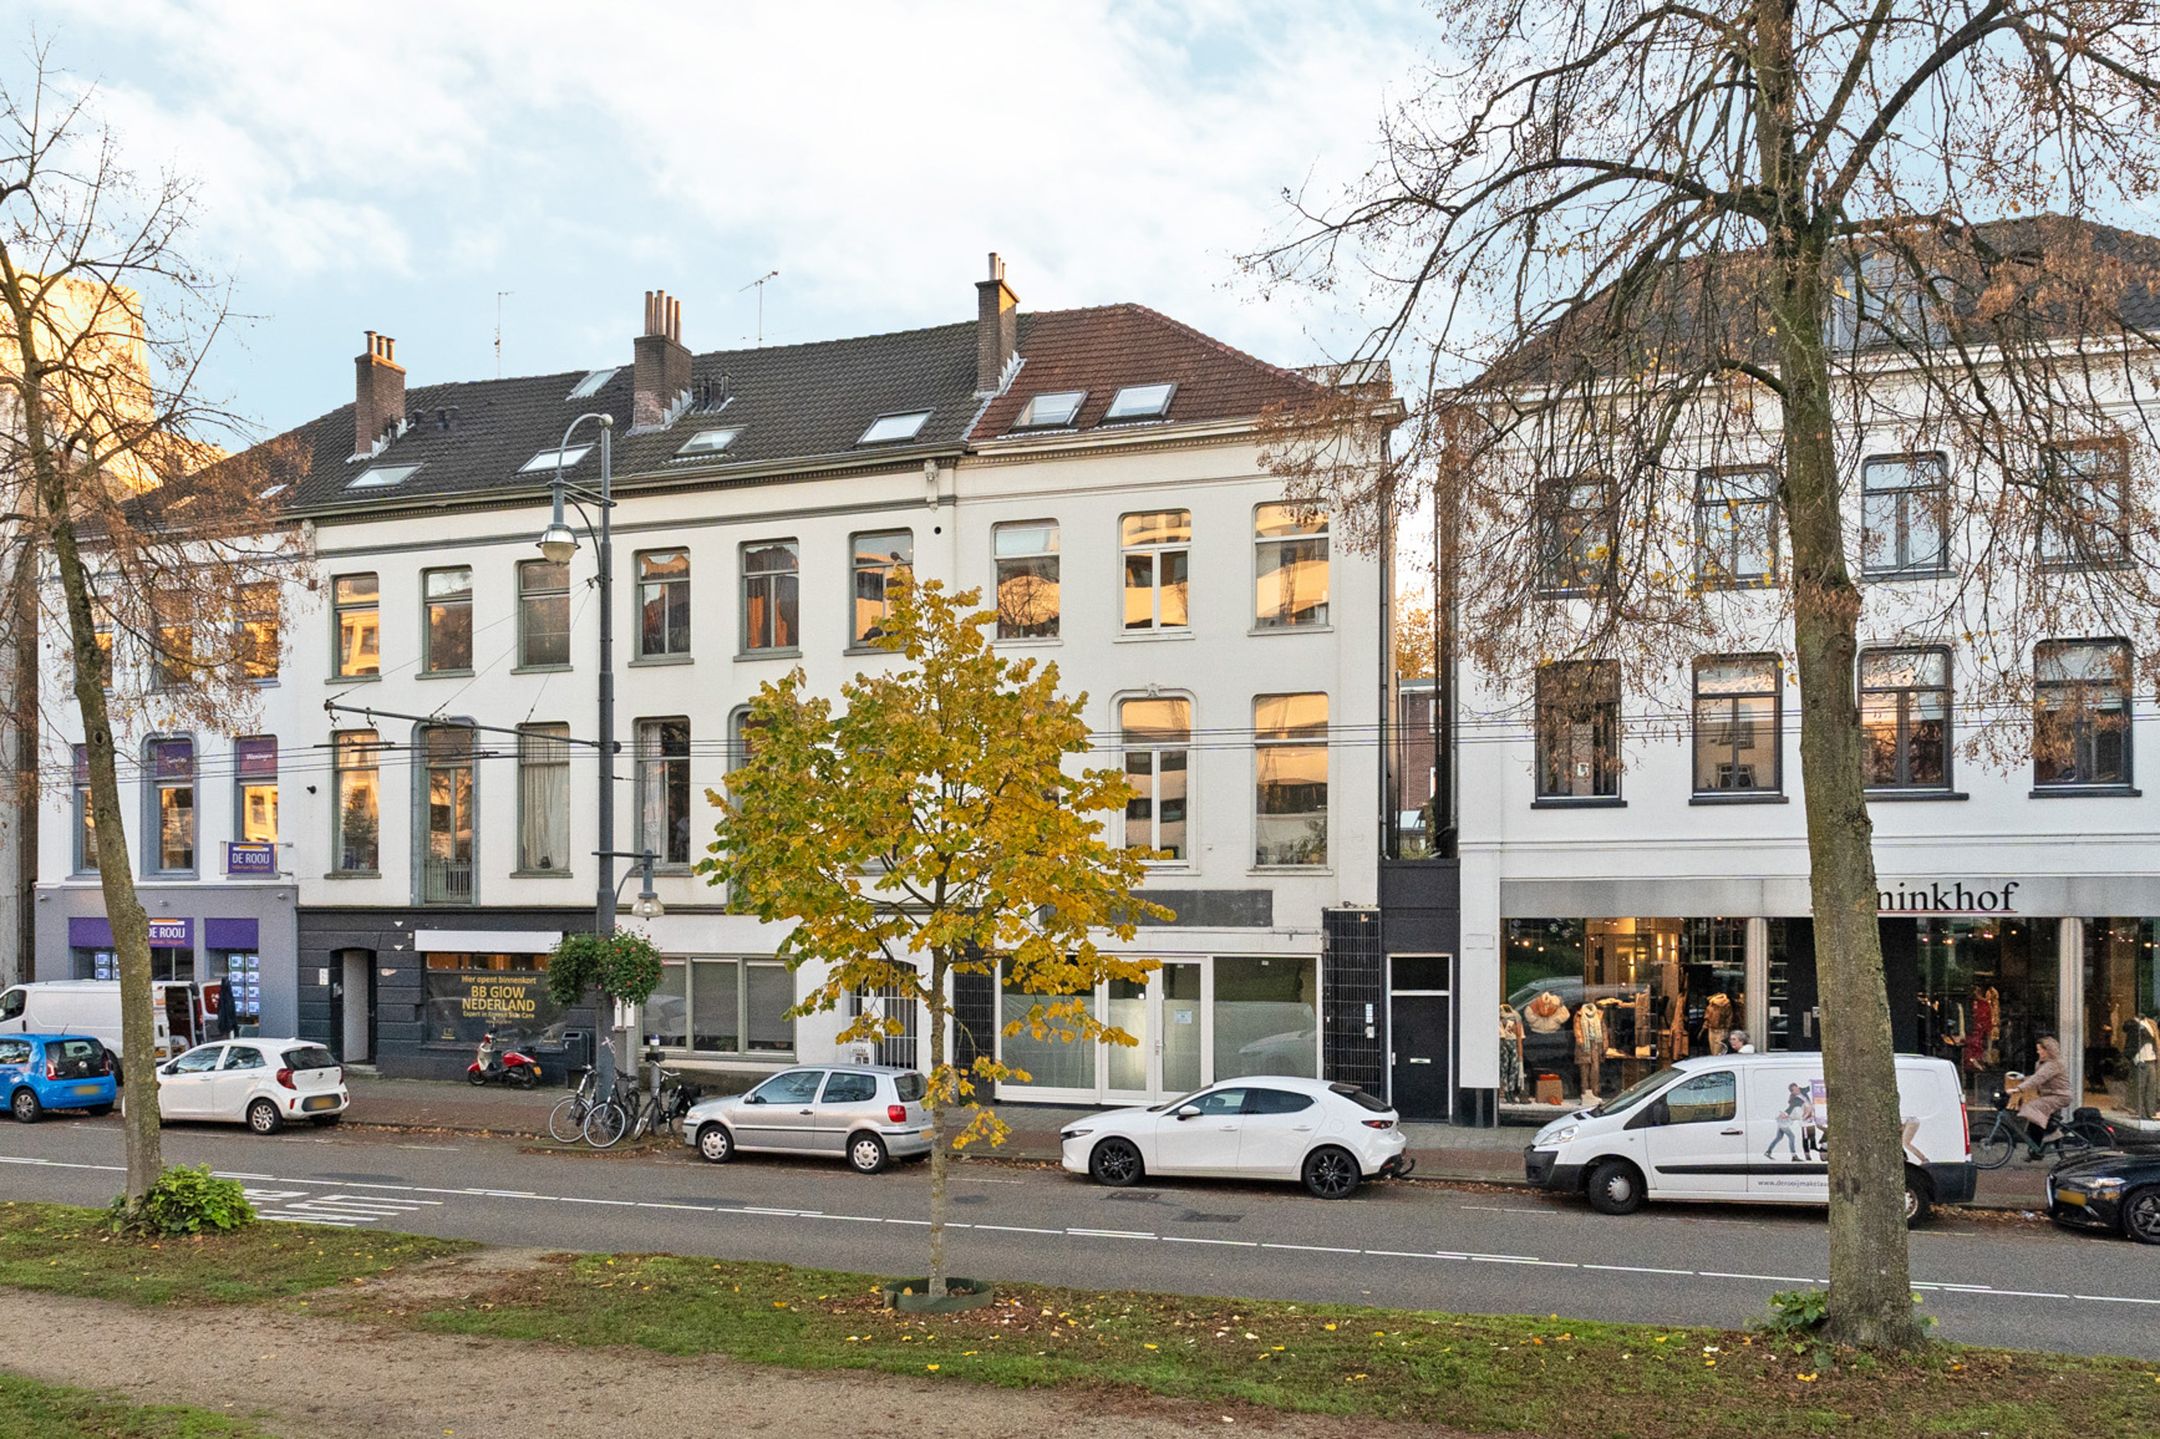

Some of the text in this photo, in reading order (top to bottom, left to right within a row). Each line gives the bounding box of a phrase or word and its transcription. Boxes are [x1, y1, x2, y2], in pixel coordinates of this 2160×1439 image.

[232, 852, 270, 865] DE ROOIJ
[1877, 881, 2020, 911] ninkhof
[160, 926, 185, 939] ROOIJ
[461, 975, 537, 984] Hier opent binnenkort
[471, 985, 487, 998] BB
[462, 998, 536, 1012] NEDERLAND
